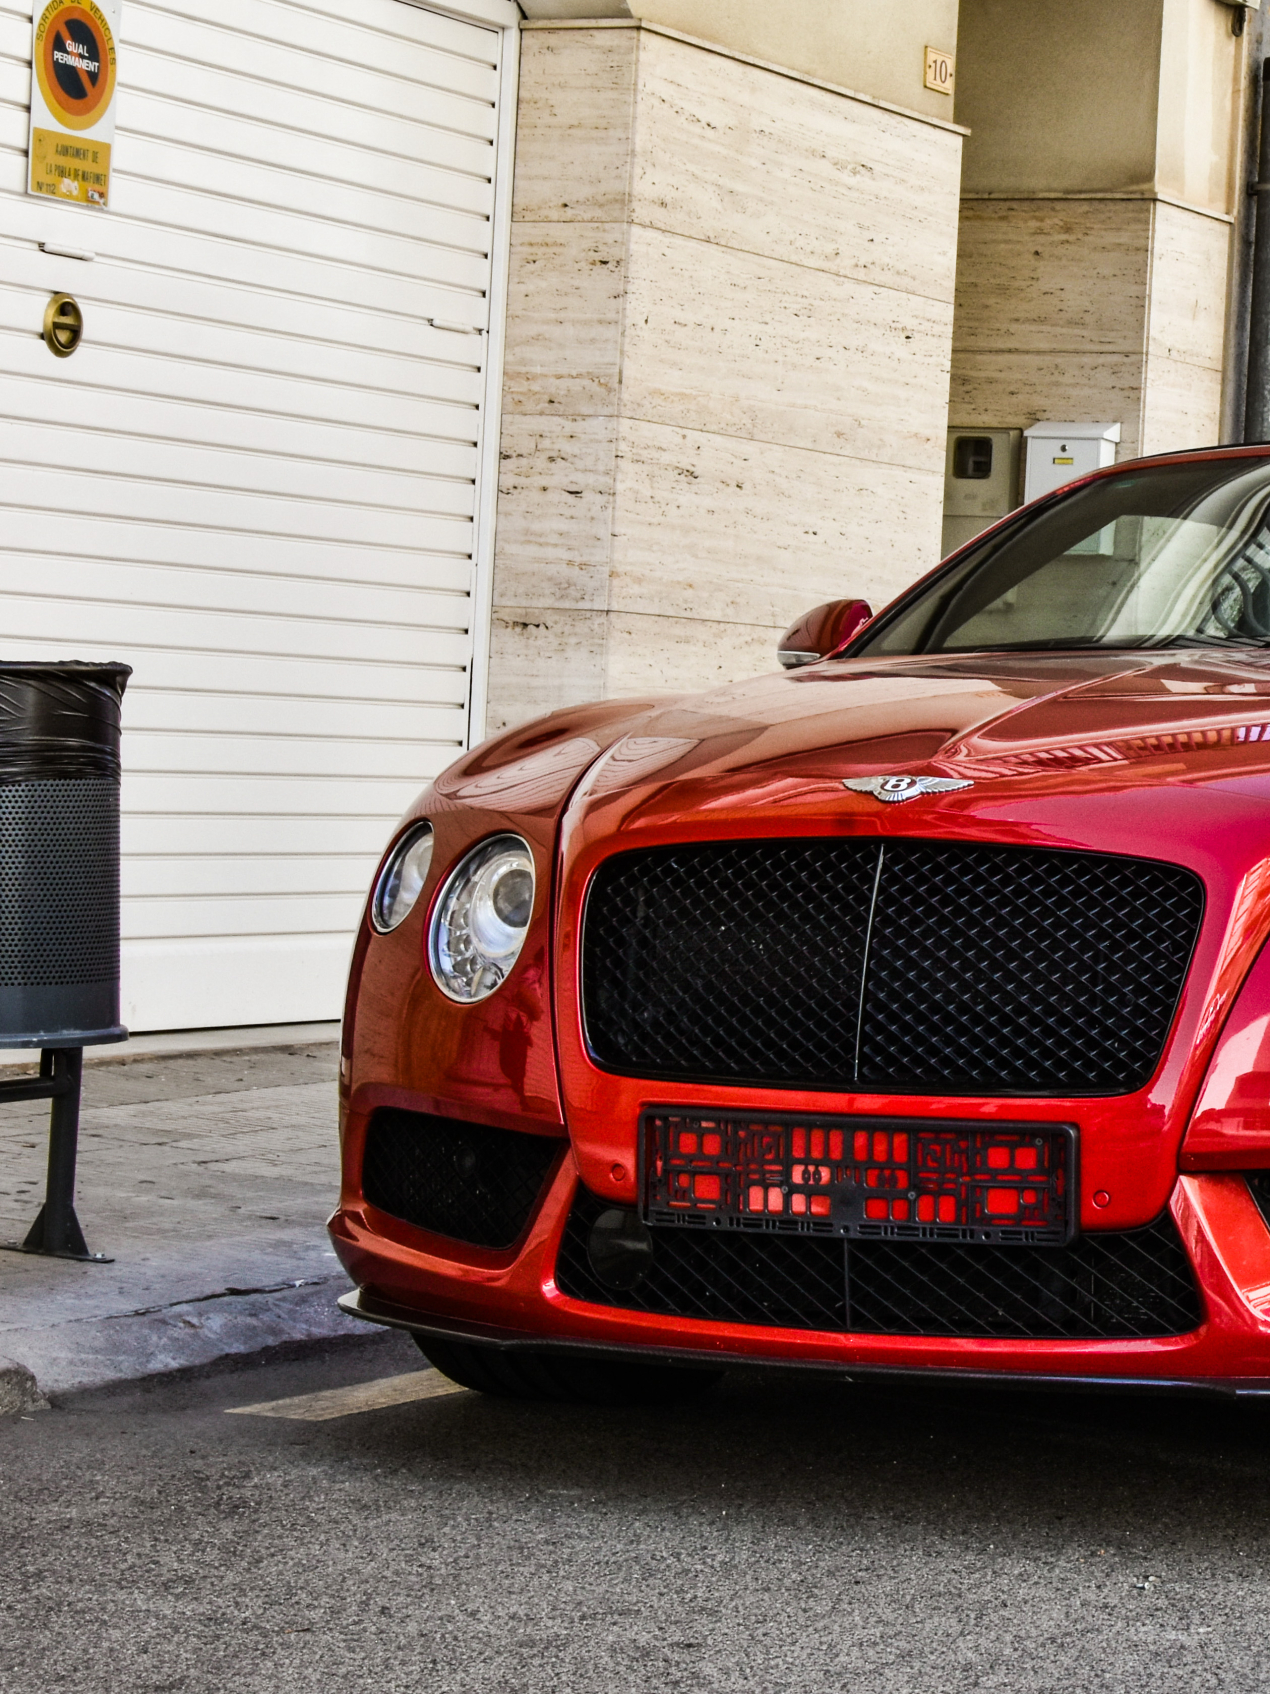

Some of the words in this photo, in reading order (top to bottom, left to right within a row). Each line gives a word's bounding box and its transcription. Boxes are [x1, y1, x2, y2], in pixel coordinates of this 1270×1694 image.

[90, 2, 116, 66] VEHICLES
[66, 40, 89, 57] GUAL
[53, 50, 99, 73] PERMANENT
[933, 59, 947, 83] 10
[55, 143, 89, 161] AJUNTAMENT
[91, 150, 99, 164] DE
[45, 162, 52, 175] LA
[54, 164, 71, 179] POBLA
[73, 168, 80, 182] DE
